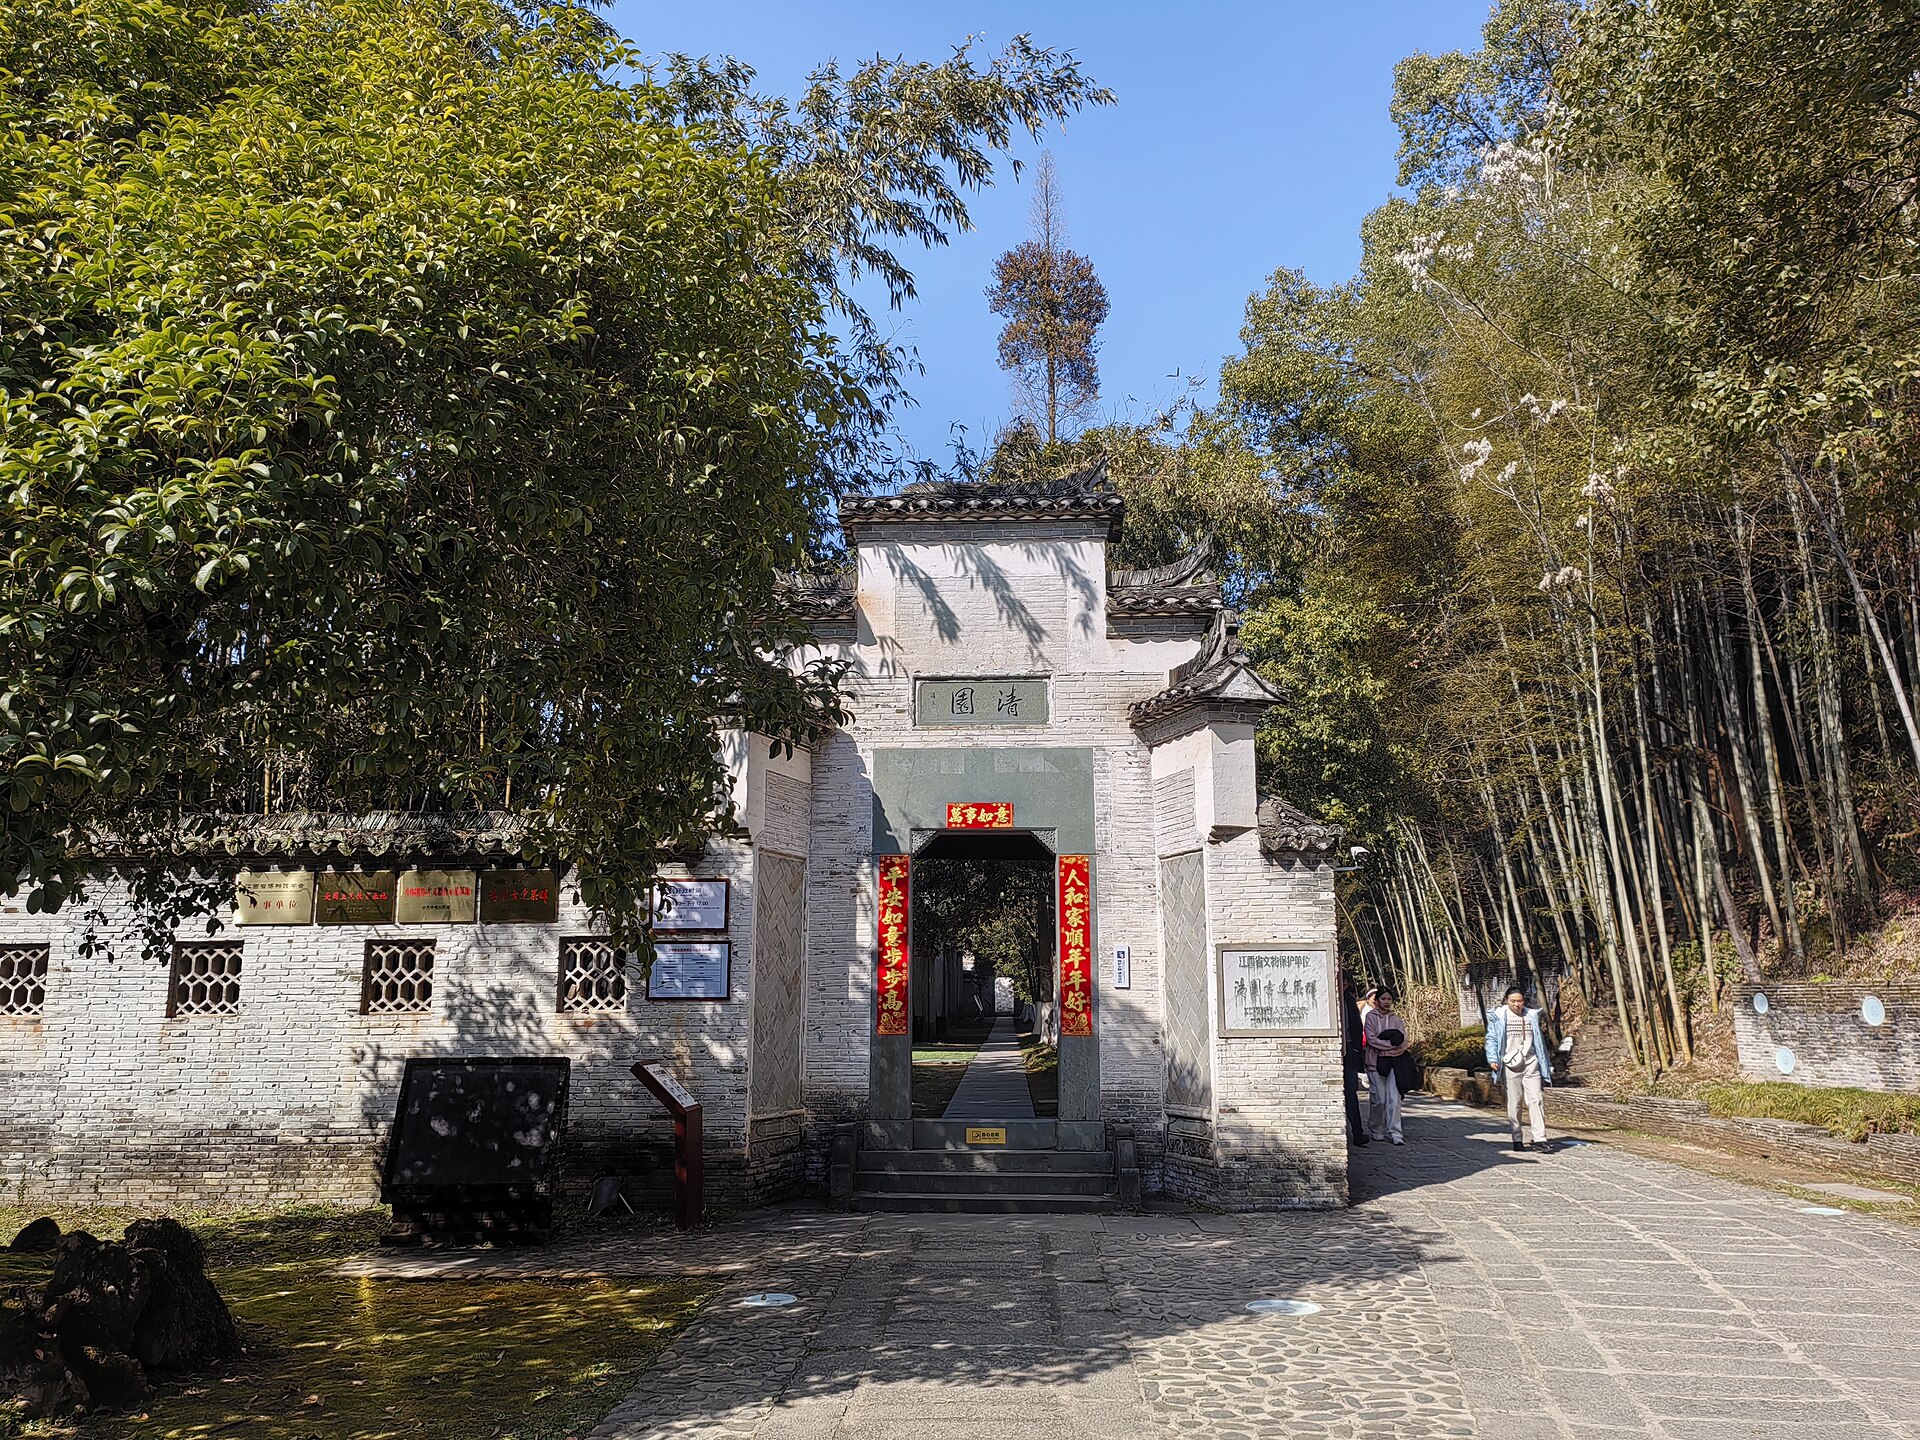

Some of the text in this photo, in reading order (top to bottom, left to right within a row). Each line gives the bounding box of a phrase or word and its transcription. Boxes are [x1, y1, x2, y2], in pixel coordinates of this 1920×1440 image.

[949, 806, 1010, 825] 萬事如意
[882, 866, 905, 1011] 平安如意步步高
[1064, 868, 1087, 1011] 人和家順年年好
[1239, 955, 1311, 968] 江西省文物保护单位
